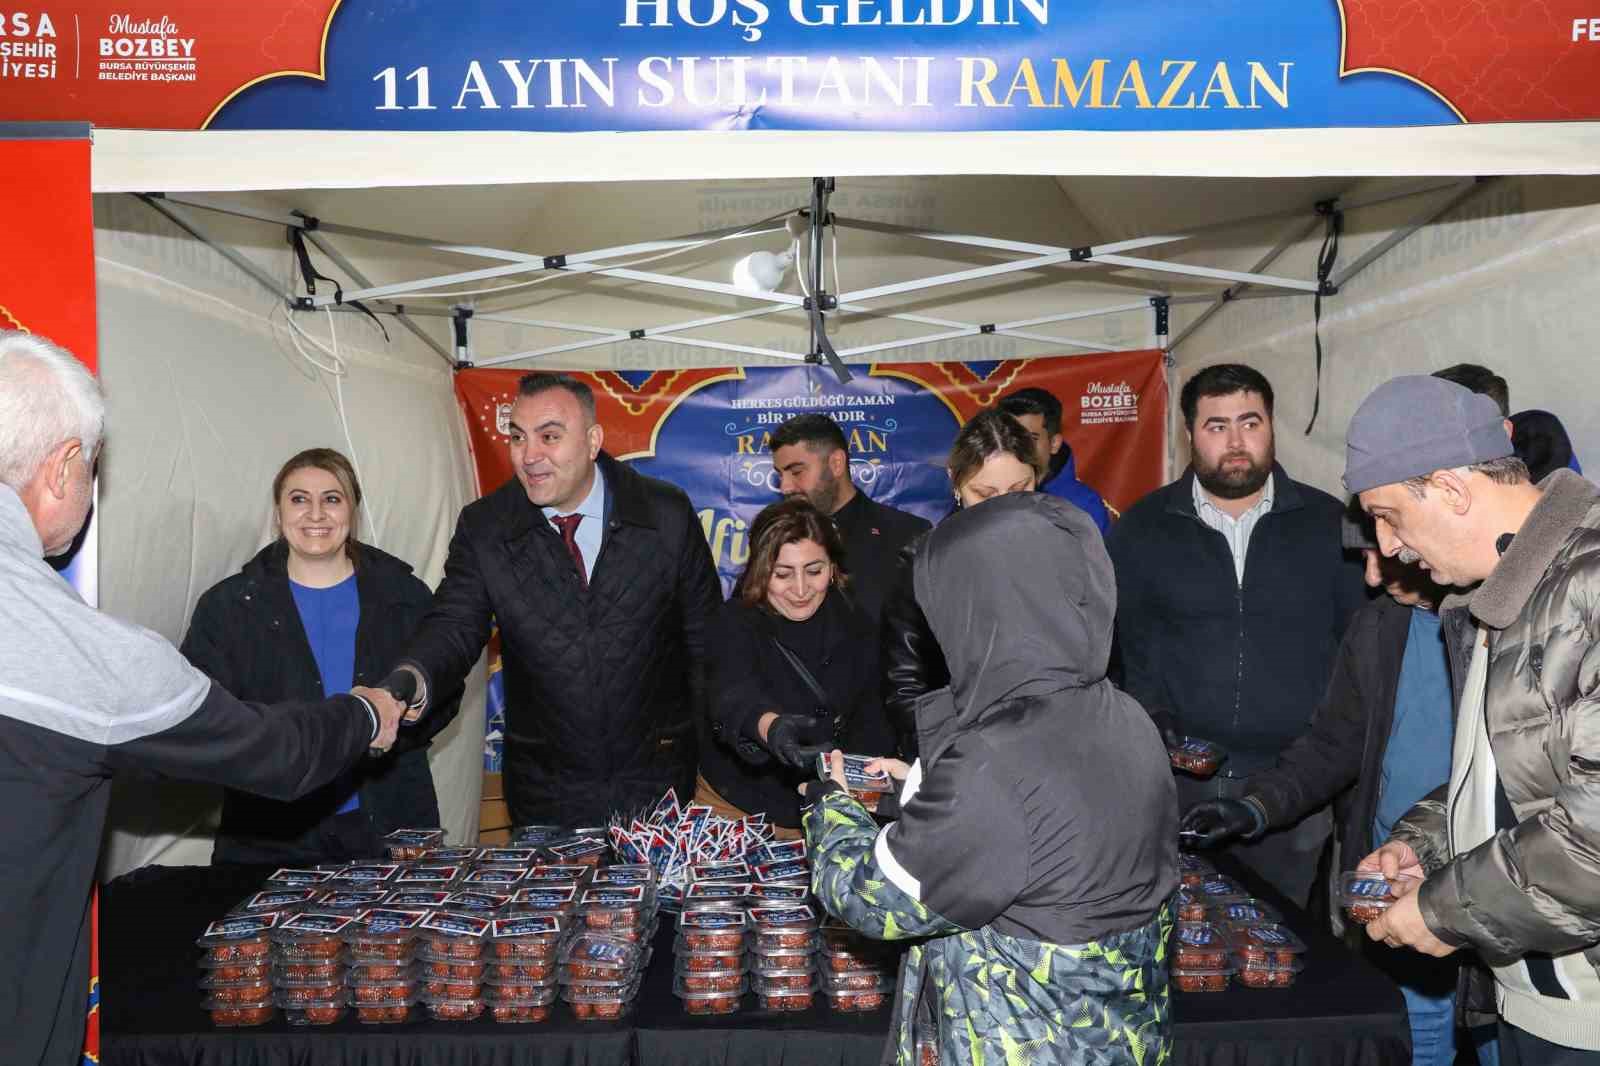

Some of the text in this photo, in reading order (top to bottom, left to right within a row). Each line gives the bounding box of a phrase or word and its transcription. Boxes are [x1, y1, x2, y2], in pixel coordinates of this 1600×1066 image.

[108, 14, 179, 40] Mustafa
[99, 38, 195, 57] BOZBEY
[135, 61, 196, 72] BÜYÜKŞEHİR
[98, 71, 196, 83] BELEDİYE BAŞKANI
[373, 56, 1295, 110] 11 AYIN SULTANI RAMAZAN
[847, 395, 895, 406] ZAMAN
[1081, 394, 1139, 408] BOZBEY
[757, 412, 783, 424] BİR
[736, 428, 888, 455] RAAN
